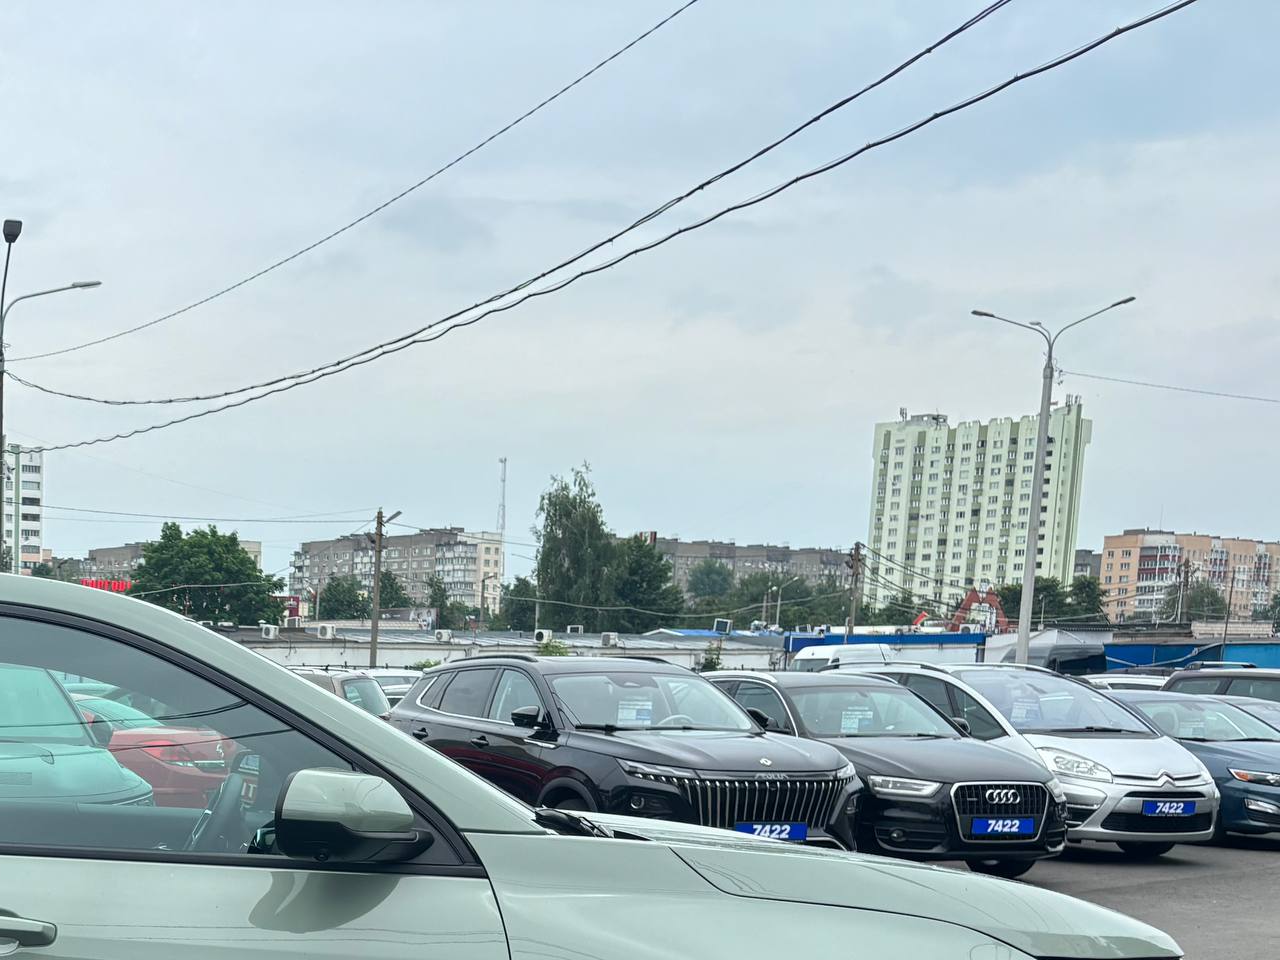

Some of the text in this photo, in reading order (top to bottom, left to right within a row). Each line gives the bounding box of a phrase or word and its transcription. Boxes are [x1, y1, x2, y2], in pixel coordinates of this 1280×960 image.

[1155, 802, 1184, 815] 7422
[752, 824, 791, 839] 7422
[986, 819, 1020, 833] 7422
